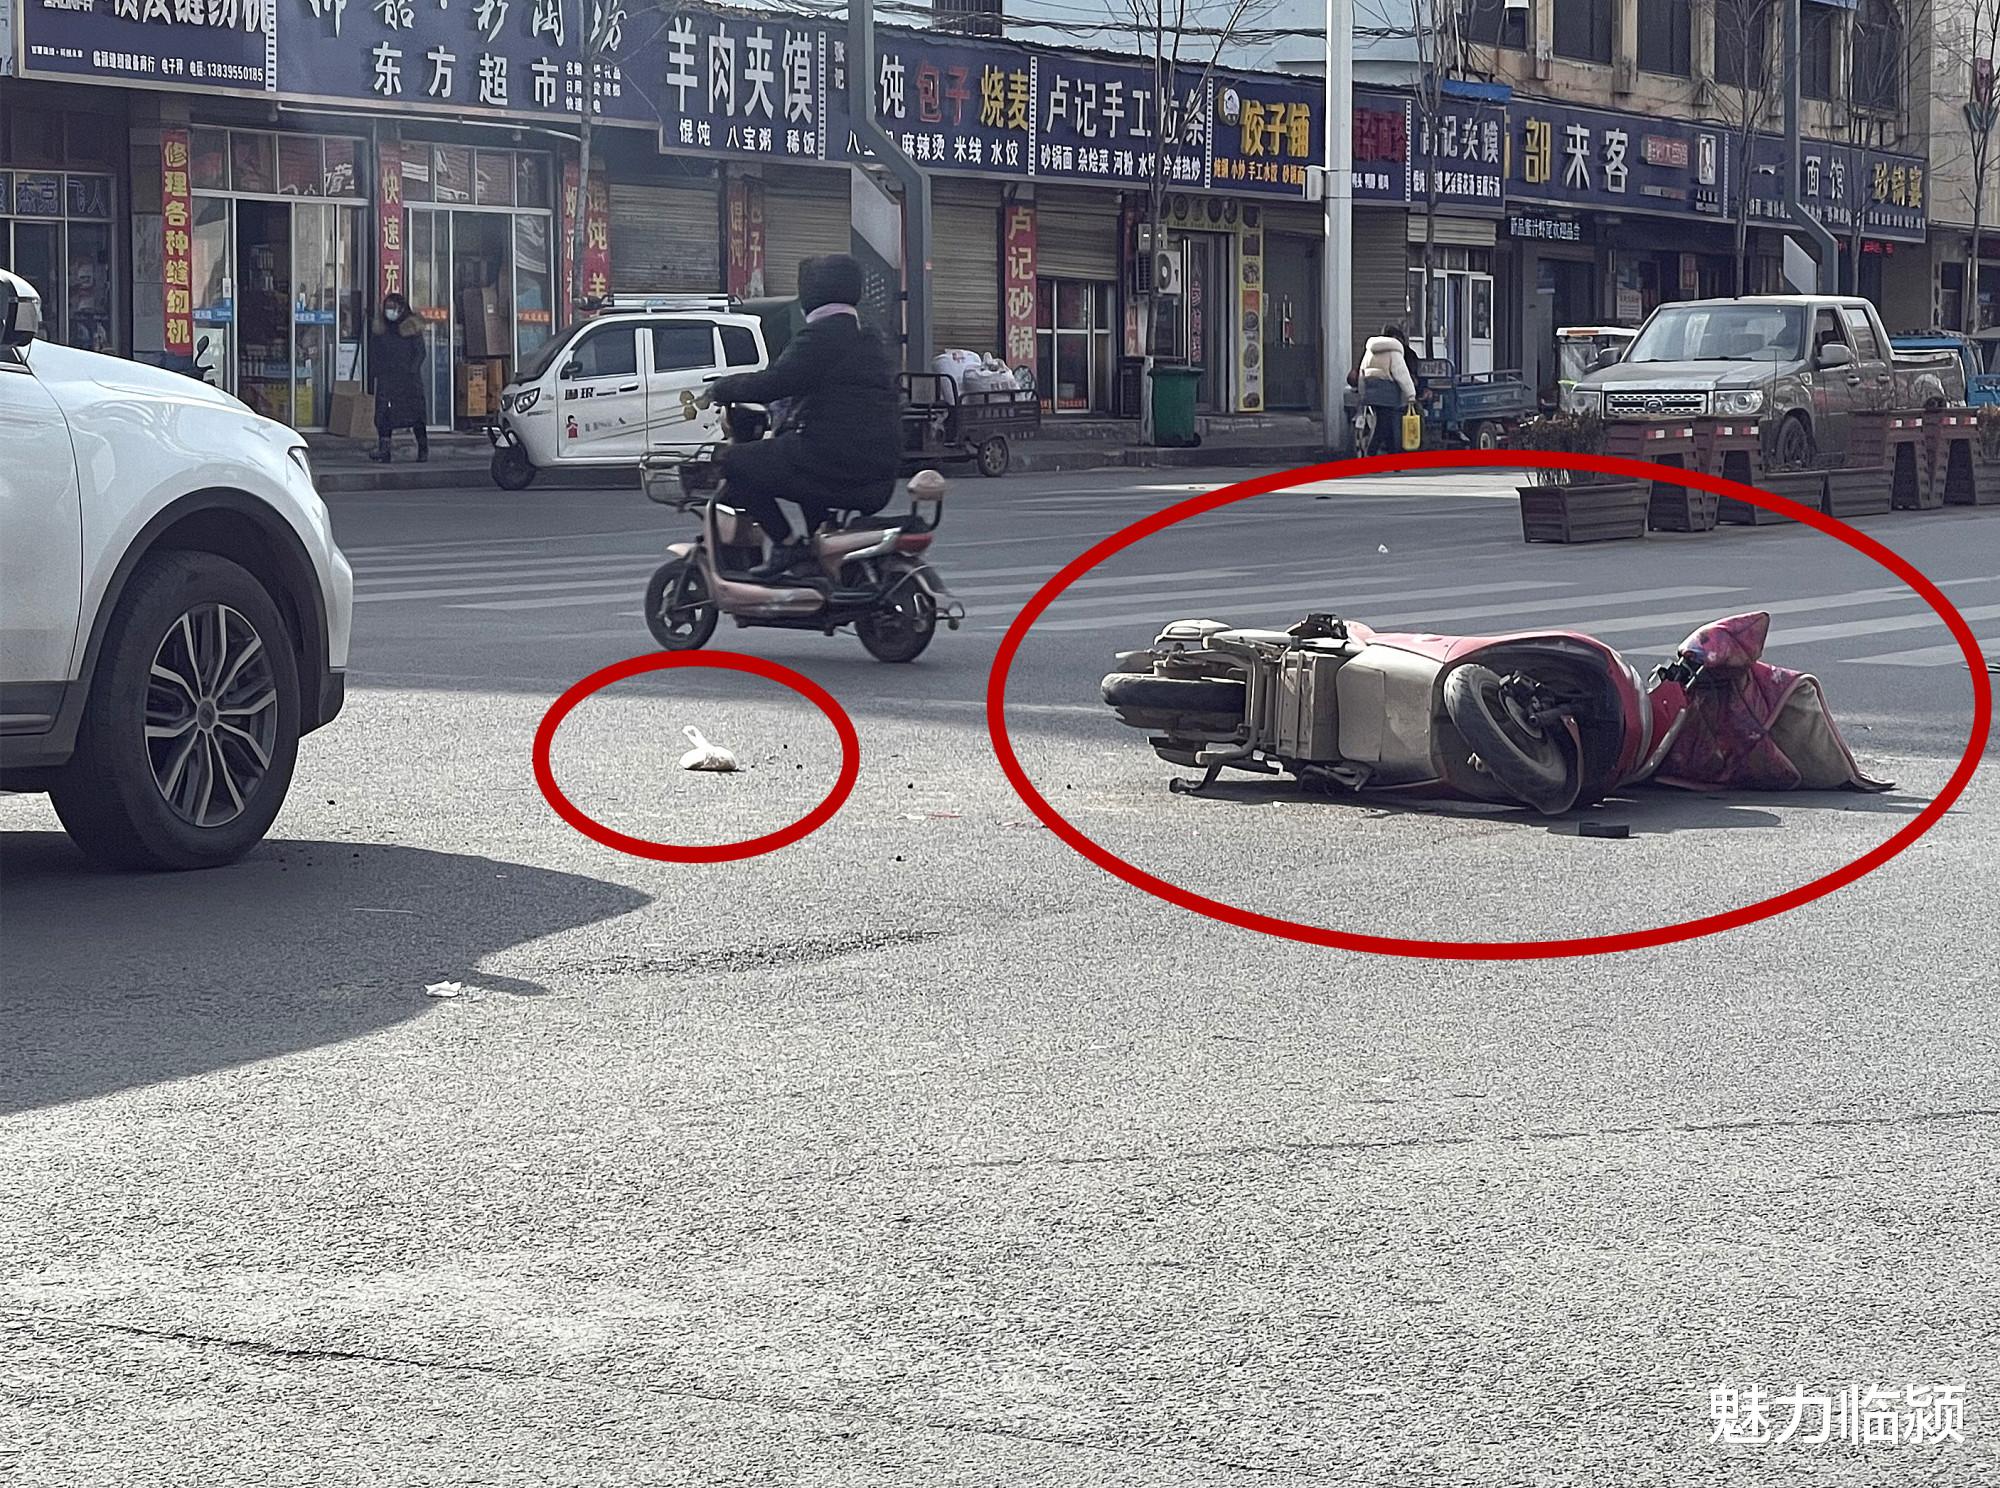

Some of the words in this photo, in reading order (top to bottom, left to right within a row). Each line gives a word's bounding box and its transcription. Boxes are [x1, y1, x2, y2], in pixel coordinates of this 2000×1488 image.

[372, 41, 559, 108] 东方超市
[666, 16, 813, 125] 羊肉夹馍
[915, 56, 971, 127] 包子
[979, 63, 1030, 132] 烧麦
[679, 118, 712, 147] 馄饨
[726, 125, 772, 152] 八宝粥
[786, 129, 816, 155] 稀饭
[901, 131, 945, 161] 麻辣烫
[953, 135, 982, 165] 米线
[989, 138, 1019, 167] 水饺
[1040, 143, 1073, 171] 砂锅面
[1112, 150, 1134, 176] 河粉
[1239, 99, 1312, 159] 饺子铺
[1758, 155, 1846, 200] 一面馆
[163, 140, 190, 345] 修理各种缝纫机
[1007, 205, 1035, 361] 卢记砂锅
